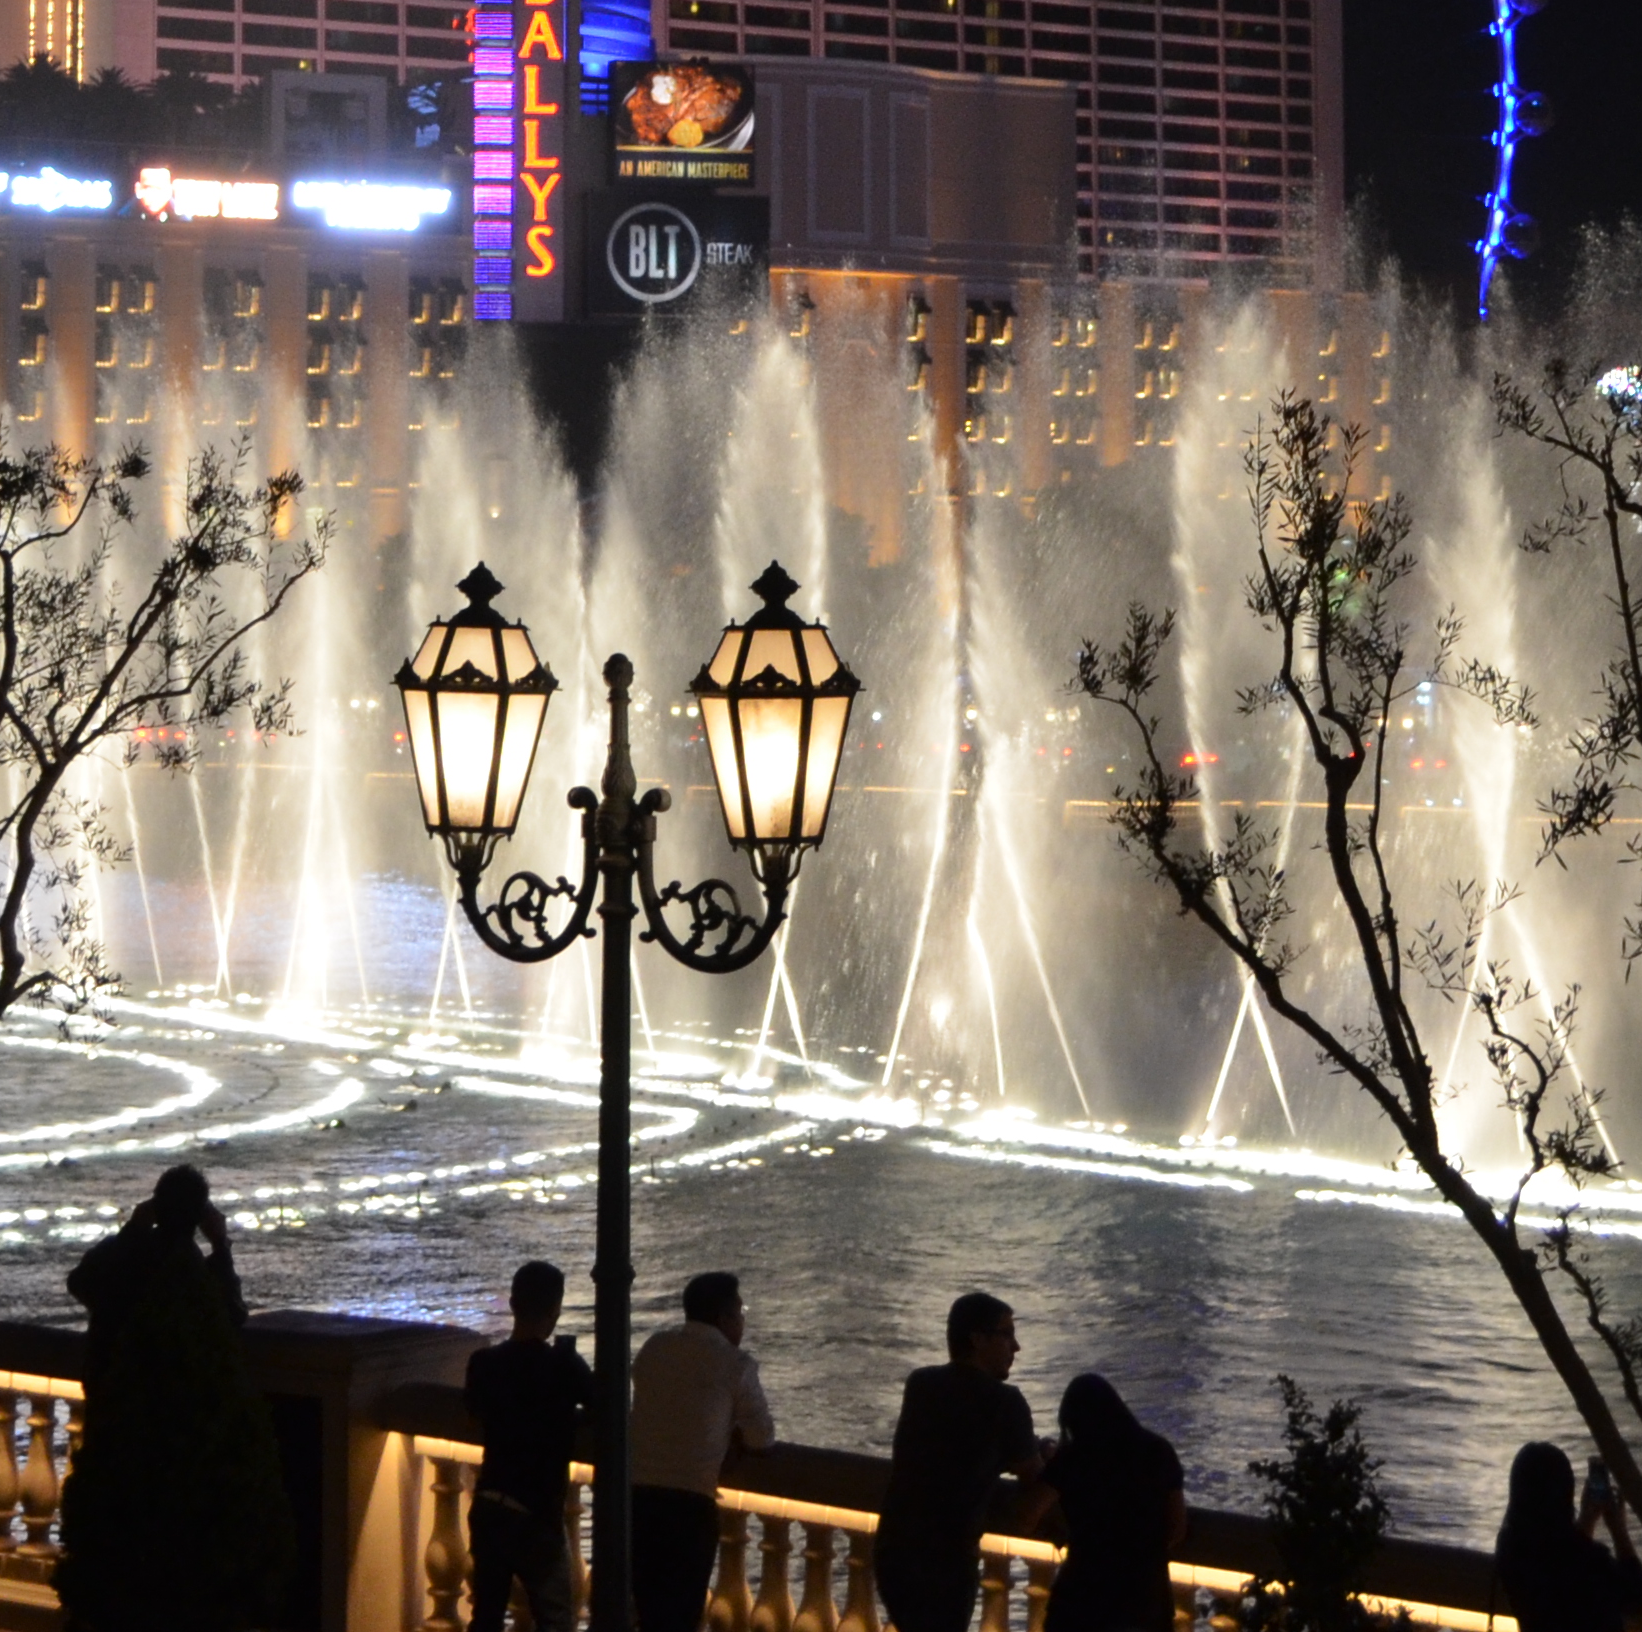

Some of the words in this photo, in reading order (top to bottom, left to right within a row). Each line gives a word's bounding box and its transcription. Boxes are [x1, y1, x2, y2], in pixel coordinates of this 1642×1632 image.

[619, 160, 634, 176] AN
[637, 160, 685, 178] AMERICAN
[687, 162, 749, 179] MASTERPIECE
[629, 225, 680, 279] BLT
[707, 242, 753, 265] STEAK
